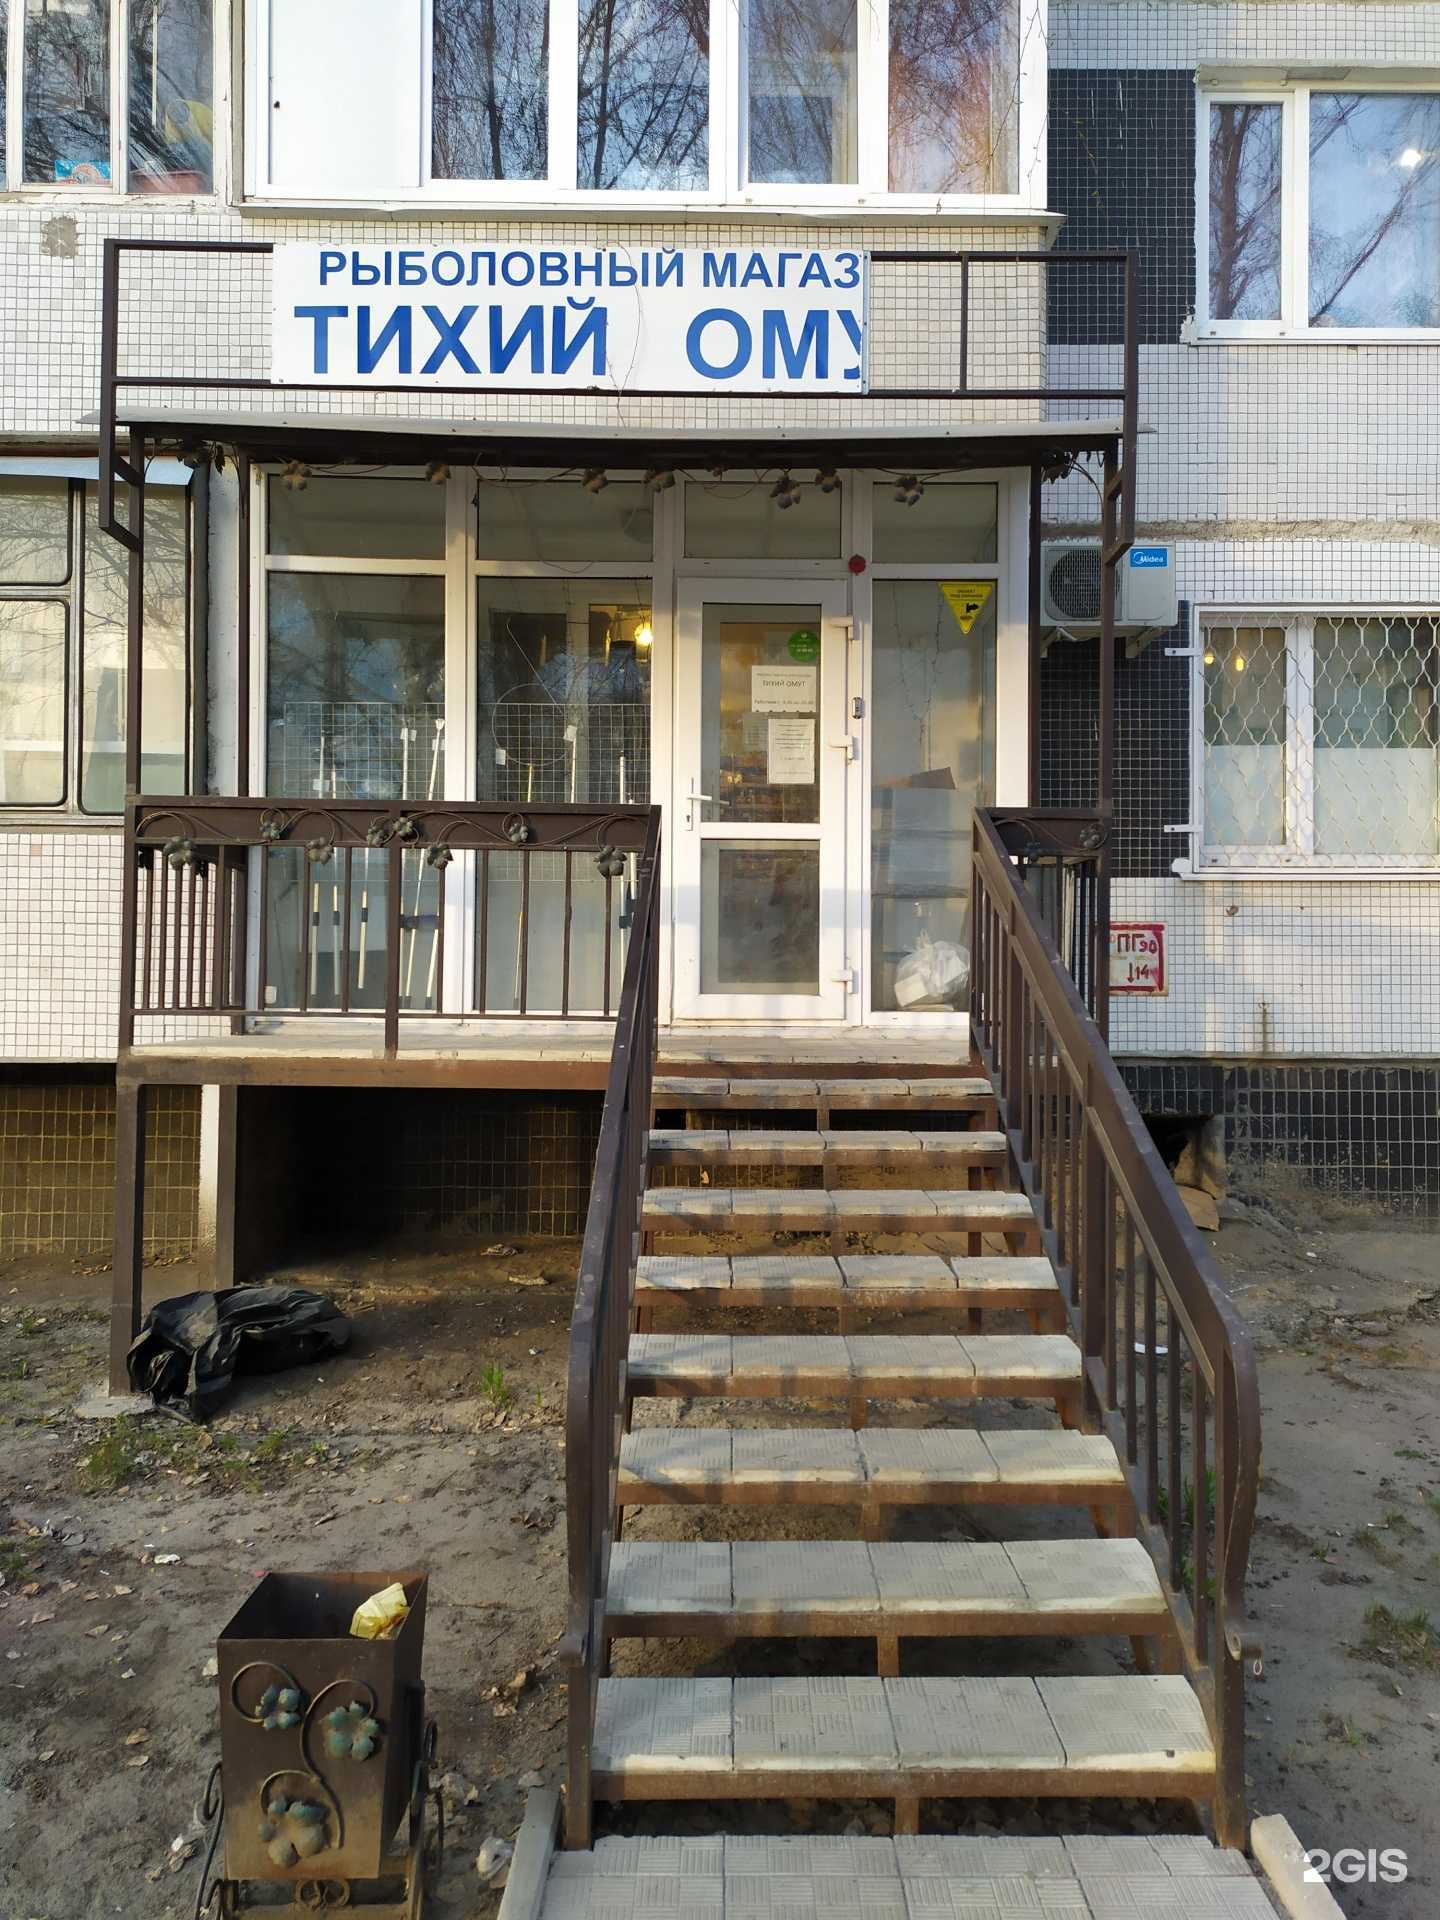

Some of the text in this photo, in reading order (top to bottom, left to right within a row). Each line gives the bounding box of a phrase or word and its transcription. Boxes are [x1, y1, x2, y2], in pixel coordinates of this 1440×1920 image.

[319, 246, 862, 289] РЫБОЛОВНЫЙ МАГАЗ
[294, 296, 608, 376] ТИХИЙ
[1138, 553, 1164, 563] Midea
